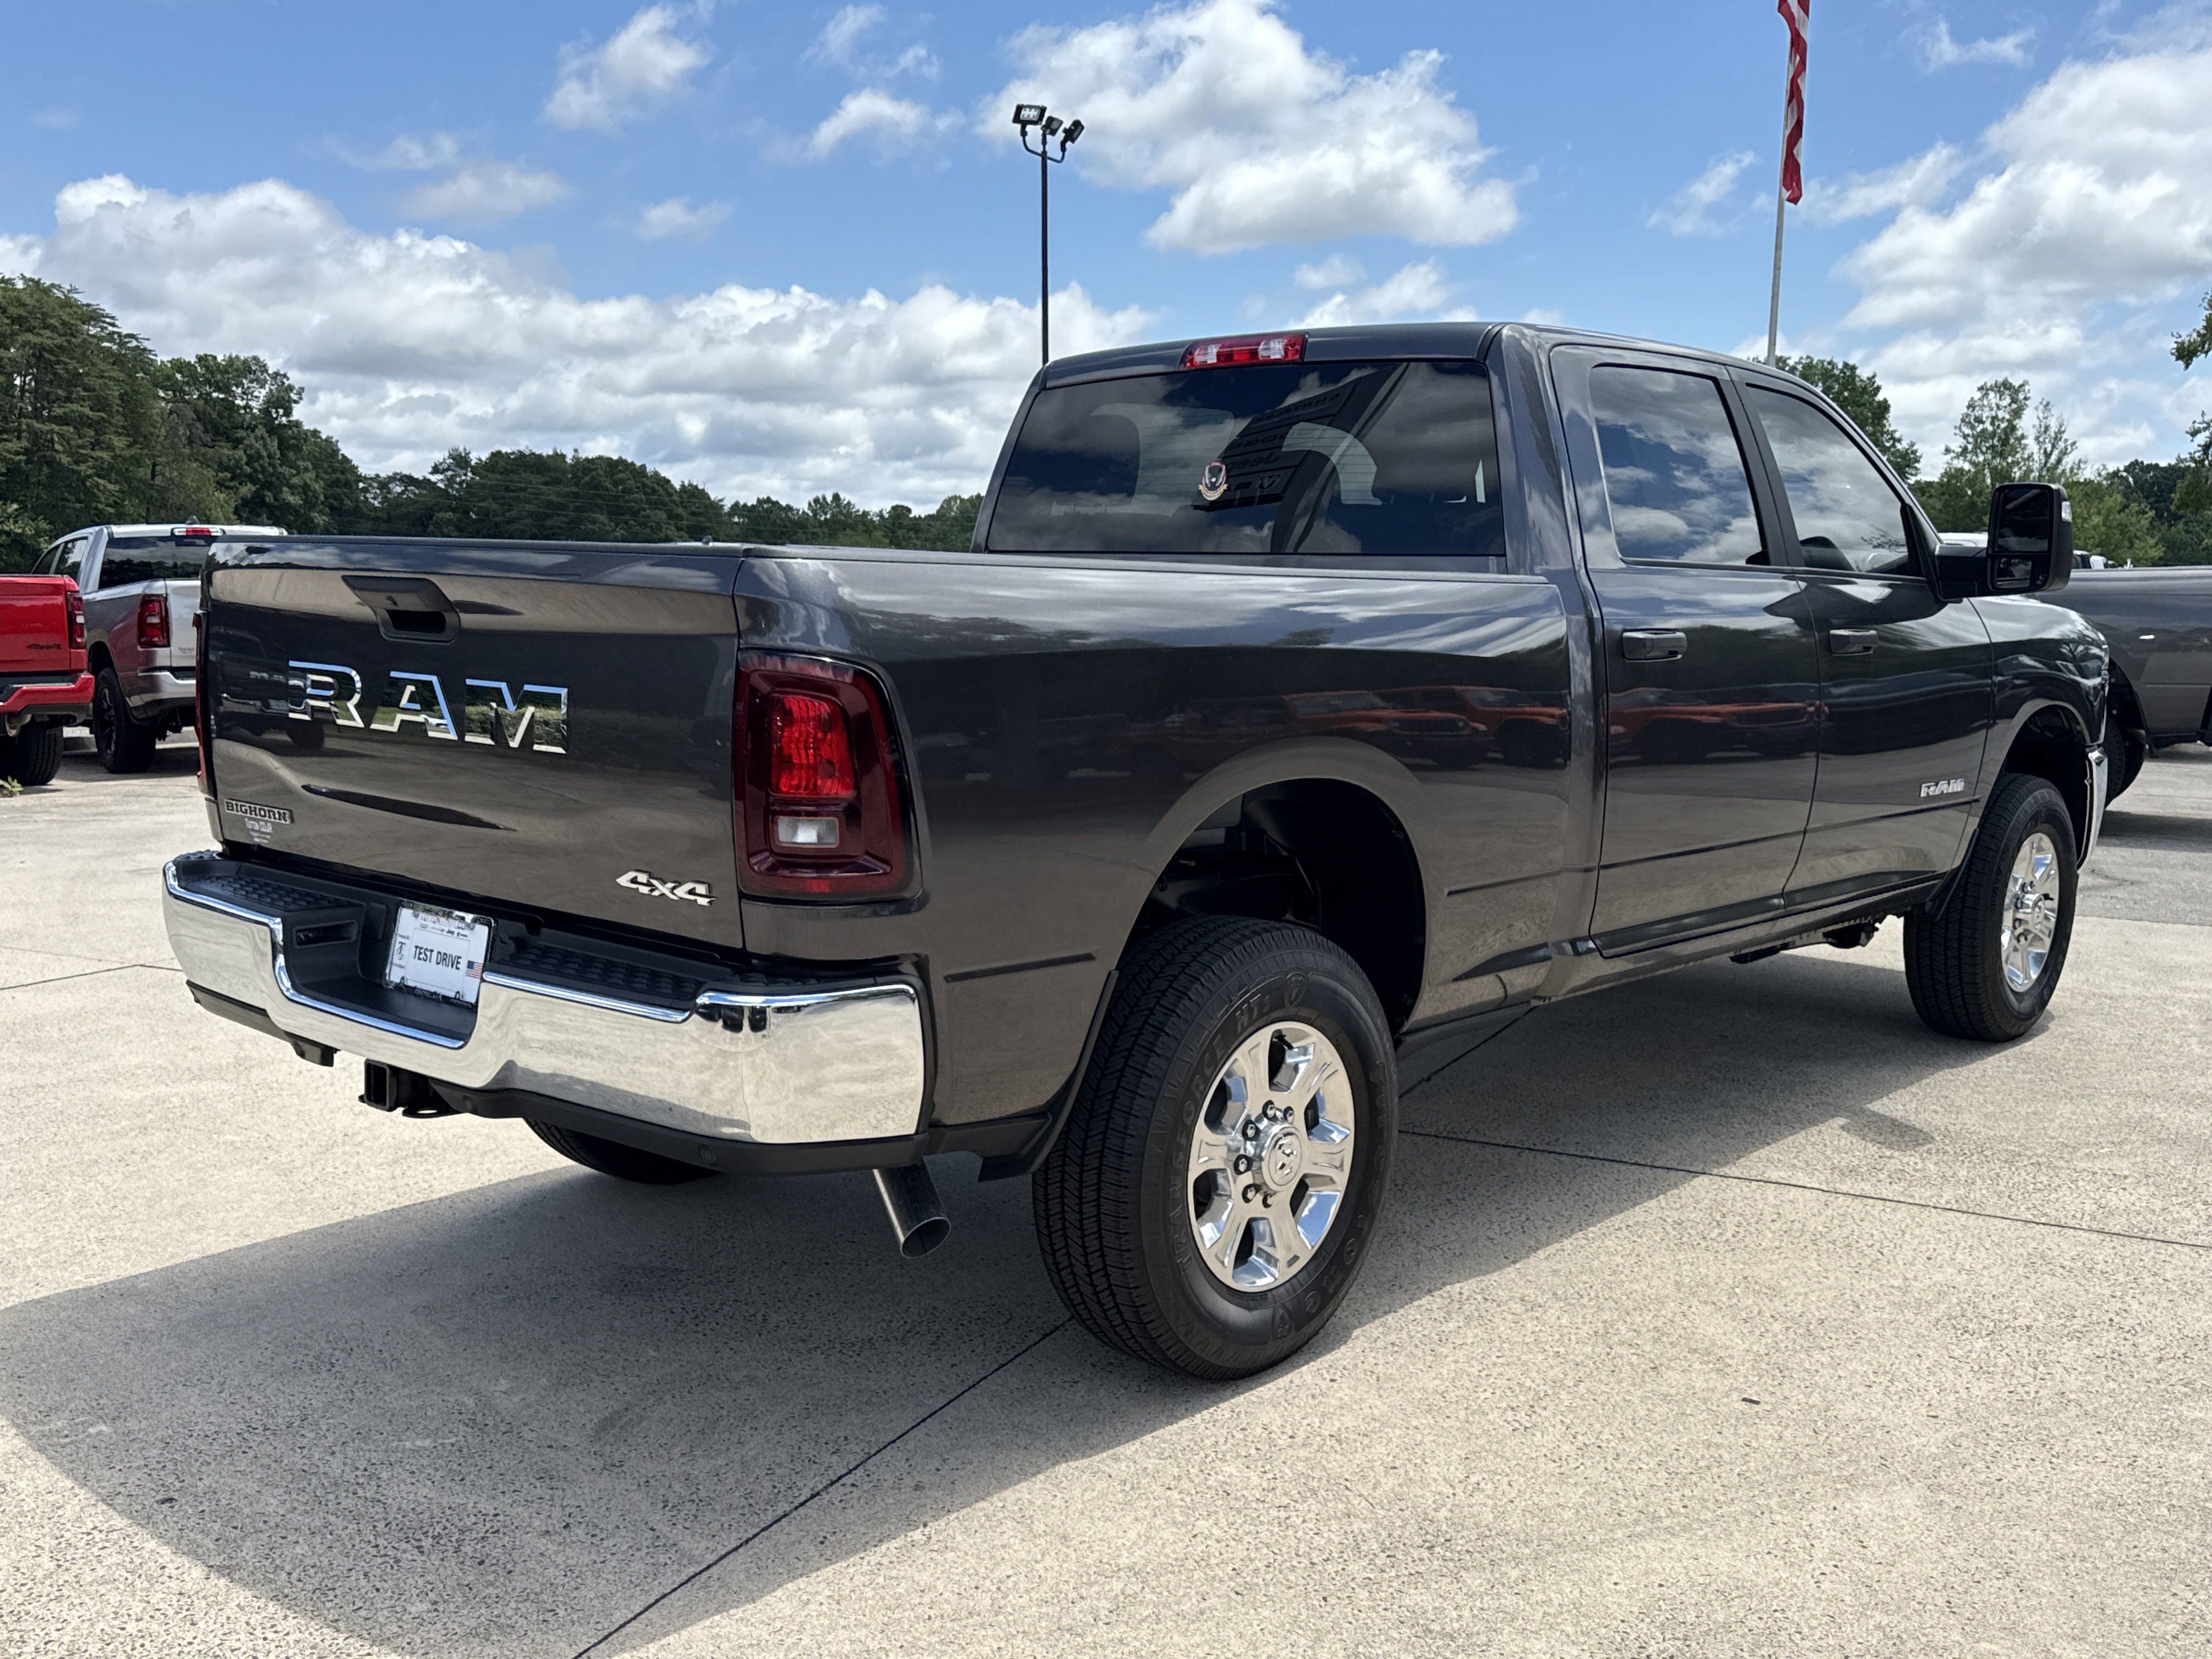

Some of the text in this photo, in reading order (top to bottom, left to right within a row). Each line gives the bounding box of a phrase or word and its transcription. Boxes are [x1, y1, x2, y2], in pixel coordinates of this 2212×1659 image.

[288, 660, 568, 754] RAM
[1920, 778, 1965, 797] RAM
[224, 799, 290, 824] BIGHORN
[413, 945, 462, 970] TEST DRIVE
[1169, 1034, 1227, 1276] TRANSFORCE
